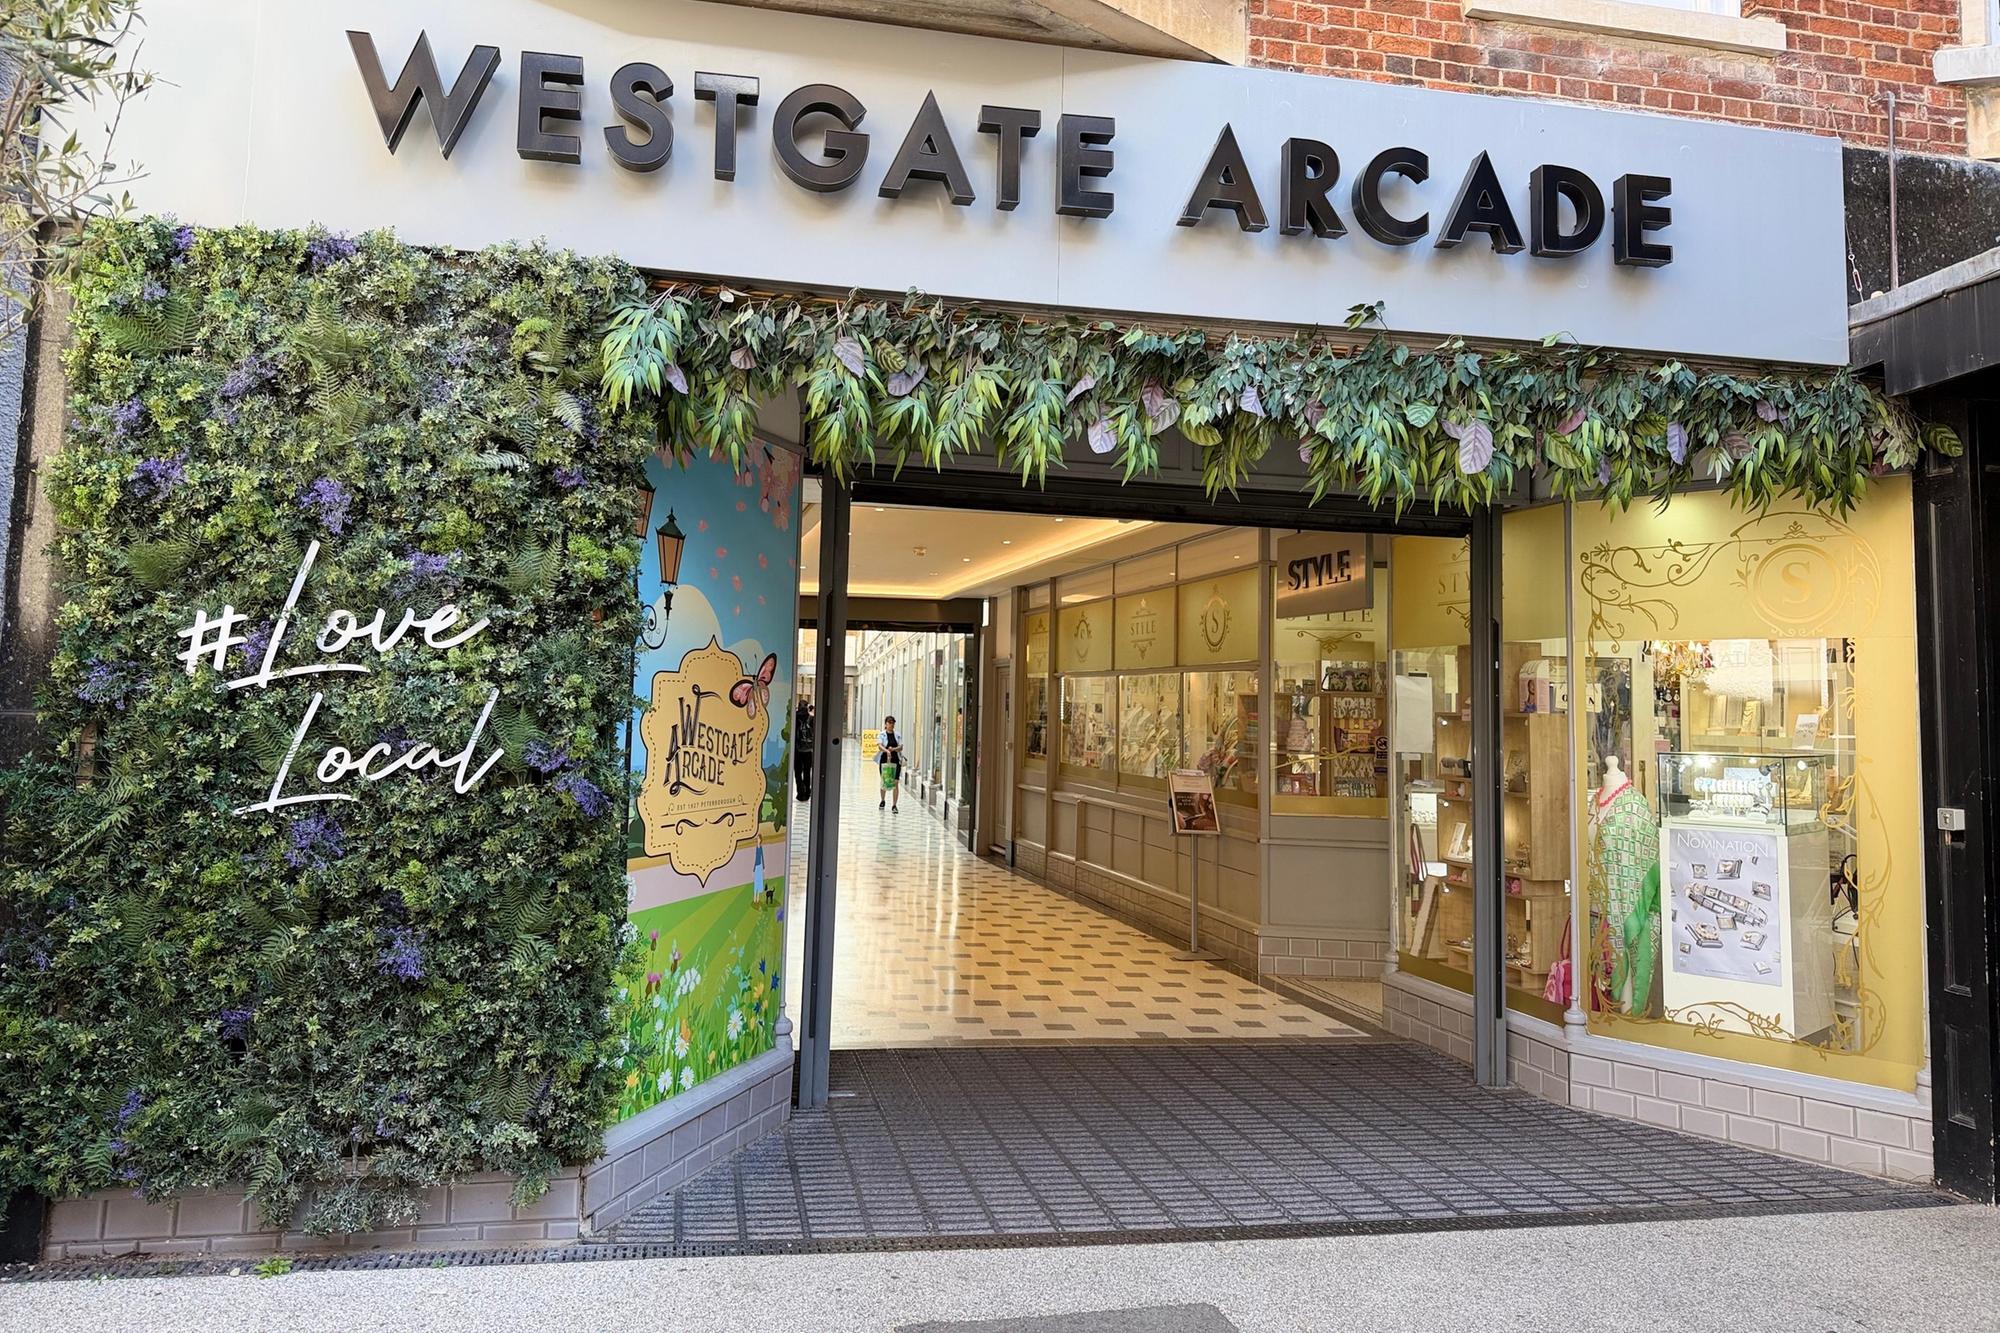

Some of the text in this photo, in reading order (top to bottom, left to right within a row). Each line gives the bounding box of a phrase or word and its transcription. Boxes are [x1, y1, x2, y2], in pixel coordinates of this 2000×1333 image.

[345, 28, 1674, 268] WESTGATE ARCADE
[1287, 549, 1352, 591] STYLE
[1782, 561, 1814, 604] S
[176, 539, 491, 693] #Love
[233, 688, 505, 815] Local
[663, 723, 726, 796] ARCADE
[678, 684, 755, 766] WESTGATE
[1677, 832, 1769, 857] NOMINATION
